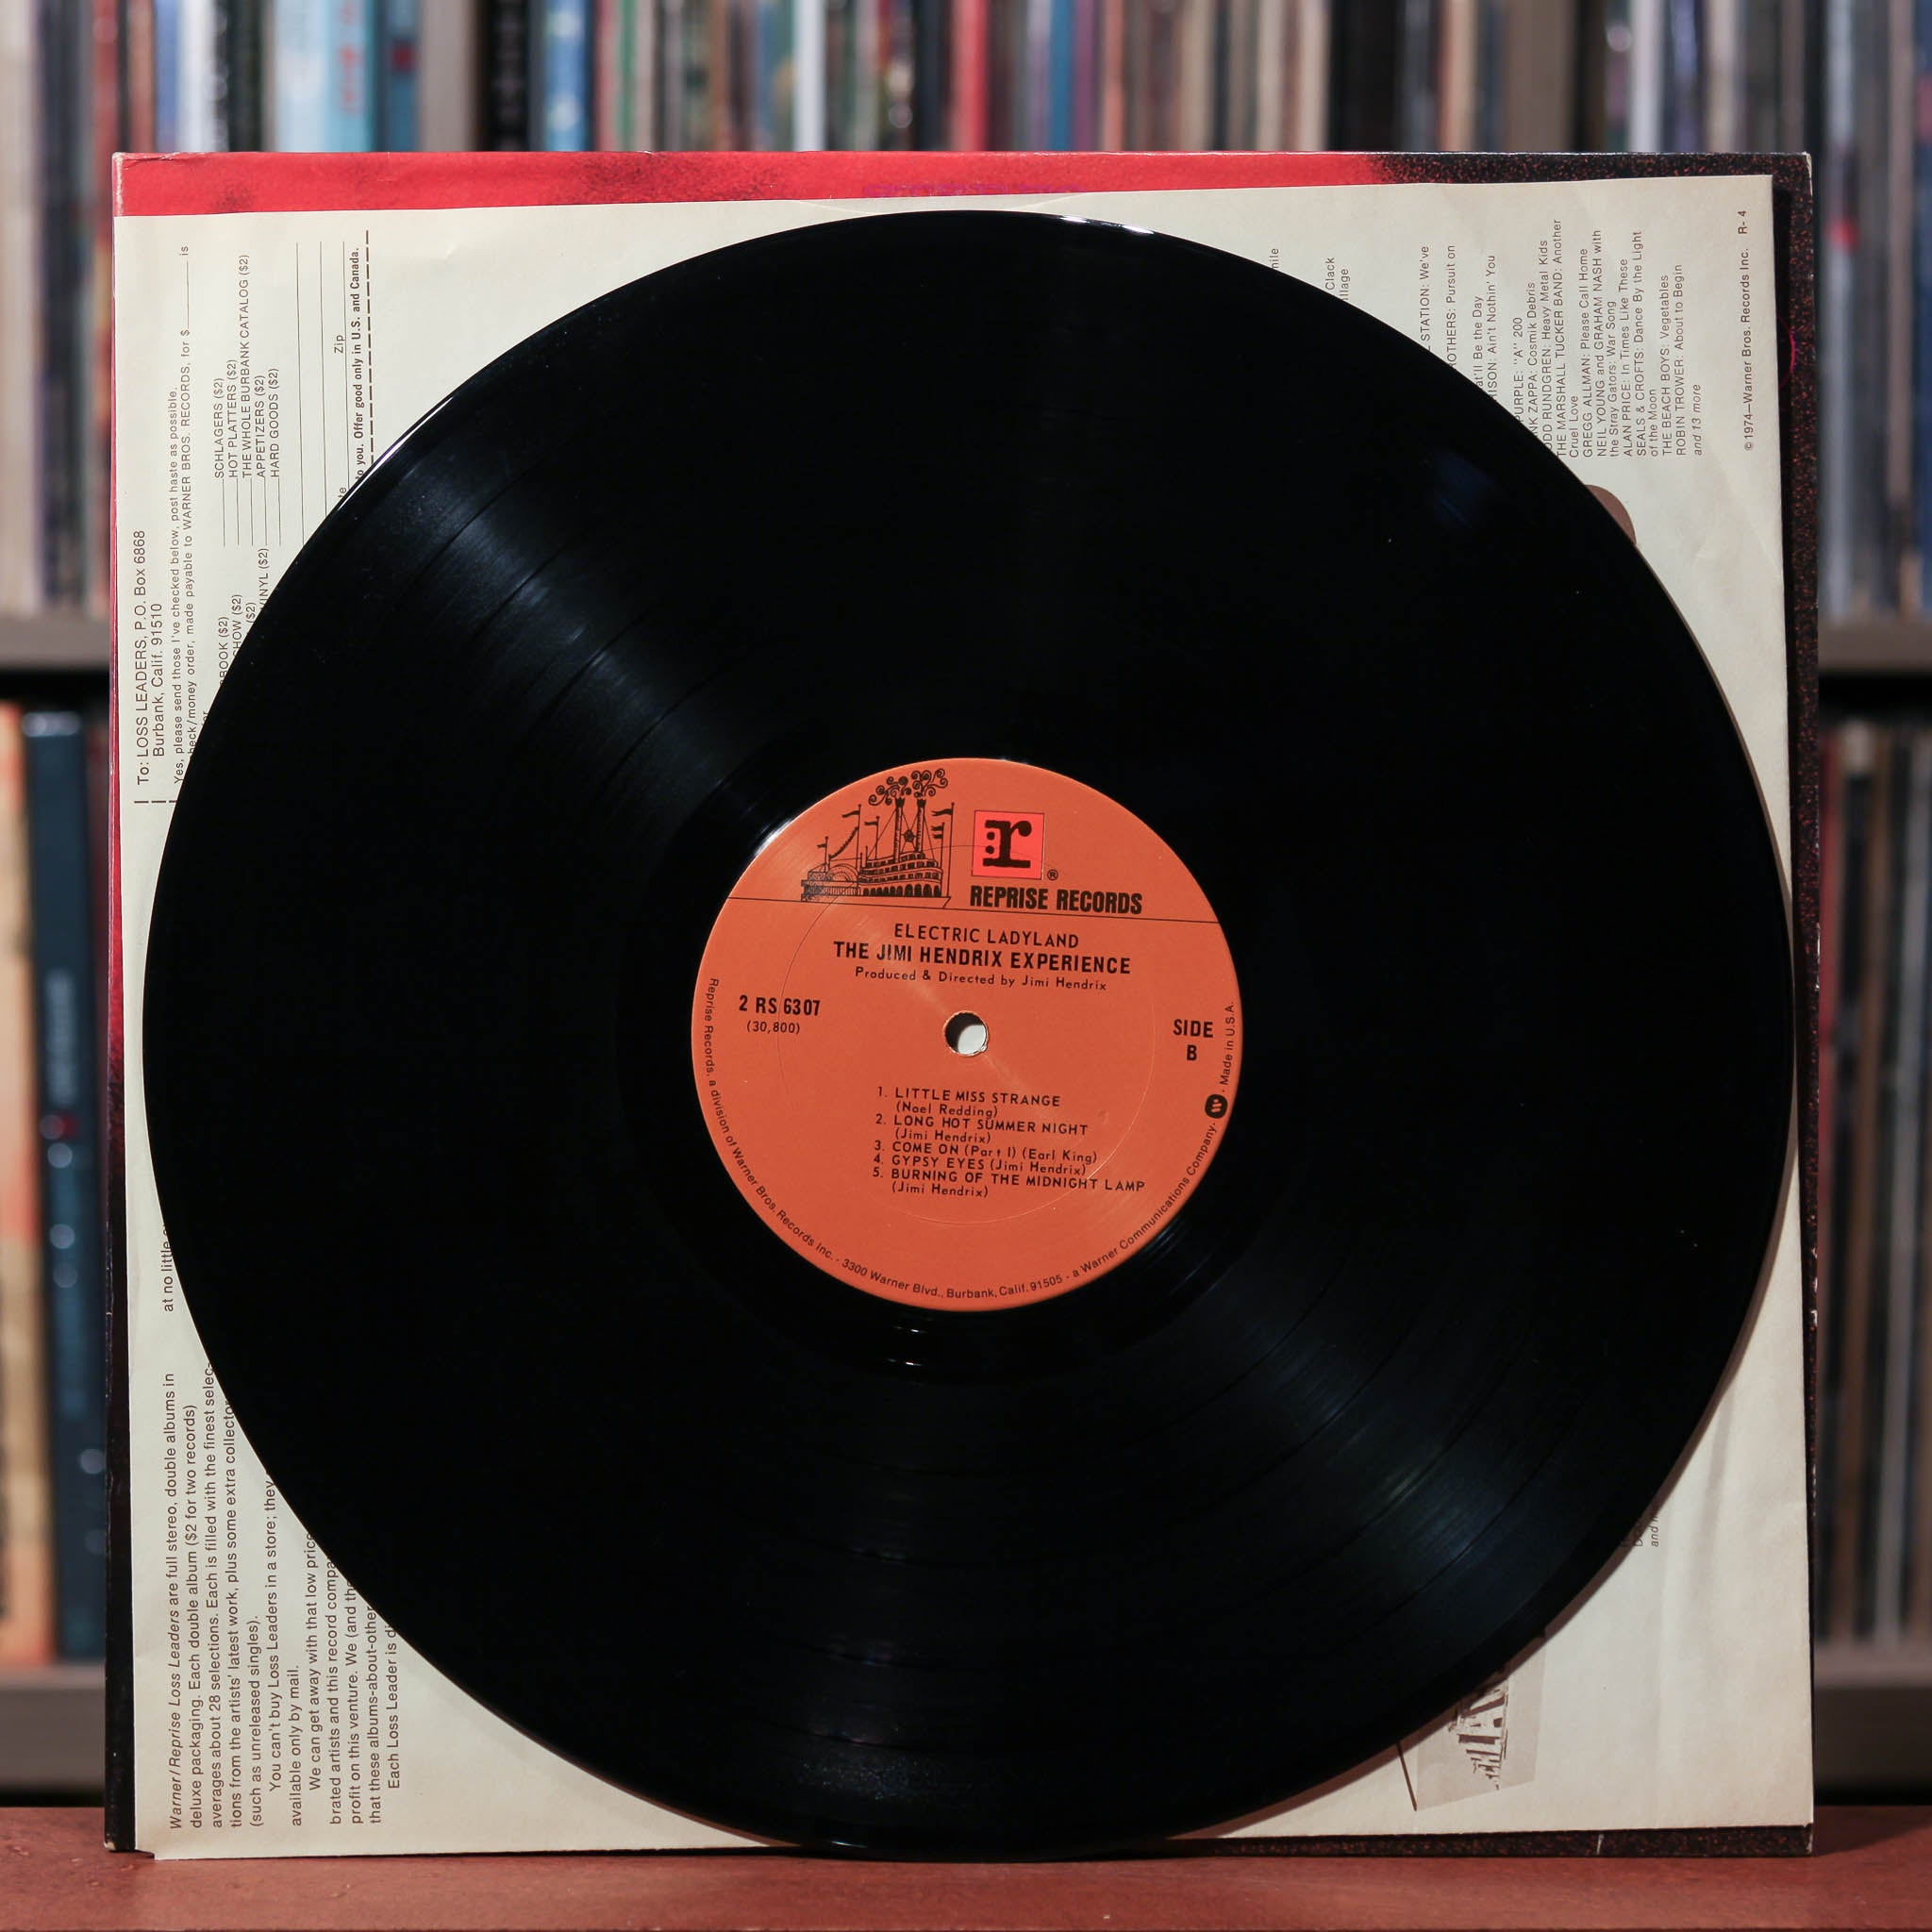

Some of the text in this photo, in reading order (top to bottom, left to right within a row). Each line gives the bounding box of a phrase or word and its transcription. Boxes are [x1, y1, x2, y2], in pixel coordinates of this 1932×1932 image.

[1739, 248, 1750, 271] Inc.
[1419, 246, 1431, 342] STATION: We've
[1739, 274, 1751, 324] Records
[333, 334, 347, 354] Zip
[1552, 219, 1568, 456] THE MARSHALL TUCKER BAND: Another
[1577, 248, 1593, 458] GREGG ALLMAN: Please Call Home
[1740, 326, 1752, 358] Bros.
[238, 255, 253, 478] THE WHOLE BURBANK CATALOG ($2)
[348, 247, 367, 466] you. Offer good only in U.S. and Canada.
[212, 377, 225, 479] SCHLAGERS ($2)
[225, 359, 239, 478] HOT PLATTERS ($2)
[253, 375, 266, 477] APPETIZERS ($2)
[267, 368, 280, 477] HARD GOODS ($2)
[1690, 384, 1703, 457] and 13 more
[132, 530, 150, 786] To: LOSS LEADERS, P.O. Box 6868
[150, 603, 165, 757] Burbank, Calif. 91510
[969, 884, 1143, 915] REPRISE RECORDS
[893, 923, 1079, 949] ELECTRIC LADYLAND
[833, 941, 1131, 974] THE JIMI HENDRIX EXPERIENCE
[855, 965, 1107, 991] Produced & Directed by Jimi Hendrix
[701, 977, 720, 1023] Reprise
[739, 994, 821, 1018] 2 RS 6307
[746, 1019, 800, 1035] (30,800)
[1173, 1018, 1214, 1039] SIDE
[1186, 1043, 1197, 1061] B
[1218, 1001, 1236, 1086] Made in U.S.A.
[704, 1079, 717, 1088] a
[878, 1086, 1060, 1108] 1. LITTLE MISS STRANGE
[707, 1089, 730, 1135] division
[875, 1112, 1089, 1136] 2. LONG HOT SUMMER NIGHT
[939, 1102, 998, 1121] Redding)
[720, 1135, 738, 1151] of
[894, 1126, 991, 1145] (Jimi Hendrix)
[1185, 1124, 1218, 1176] Company
[731, 1146, 758, 1189] Warner
[873, 1152, 1087, 1177] 4. GYPSY EYES (Jimi Hendrix)
[874, 1139, 885, 1152] 3.
[891, 1141, 933, 1155] COME
[938, 1142, 959, 1156] ON
[964, 1143, 1001, 1158] (Part
[1022, 1146, 1058, 1163] (Earl
[1061, 1148, 1097, 1165] King)
[872, 1166, 1145, 1192] 5. BURNING OF THE MIDNIGHT LAMP
[891, 1180, 989, 1198] (Jimi Hendrix)
[754, 1185, 776, 1213] Bros.
[1119, 1176, 1191, 1250] Communications
[775, 1208, 815, 1247] Records
[814, 1241, 834, 1261] Inc.
[1079, 1247, 1119, 1274] Warner
[159, 1241, 174, 1312] at no little
[841, 1257, 869, 1277] 3300
[870, 1269, 910, 1291] Warner
[1029, 1274, 1063, 1291] 91505
[1072, 1269, 1080, 1278] a
[998, 1282, 1028, 1297] Calif.
[162, 1374, 175, 1387] in
[162, 1391, 176, 1443] albums
[163, 1447, 177, 1498] double
[165, 1502, 178, 1552] stereo,
[165, 1556, 178, 1579] full
[168, 1582, 179, 1606] are
[167, 1609, 180, 1668] Leaders
[168, 1673, 181, 1707] Loss
[245, 1615, 264, 1827] (such as unreleased singles).
[286, 1665, 304, 1826] available only by mail.
